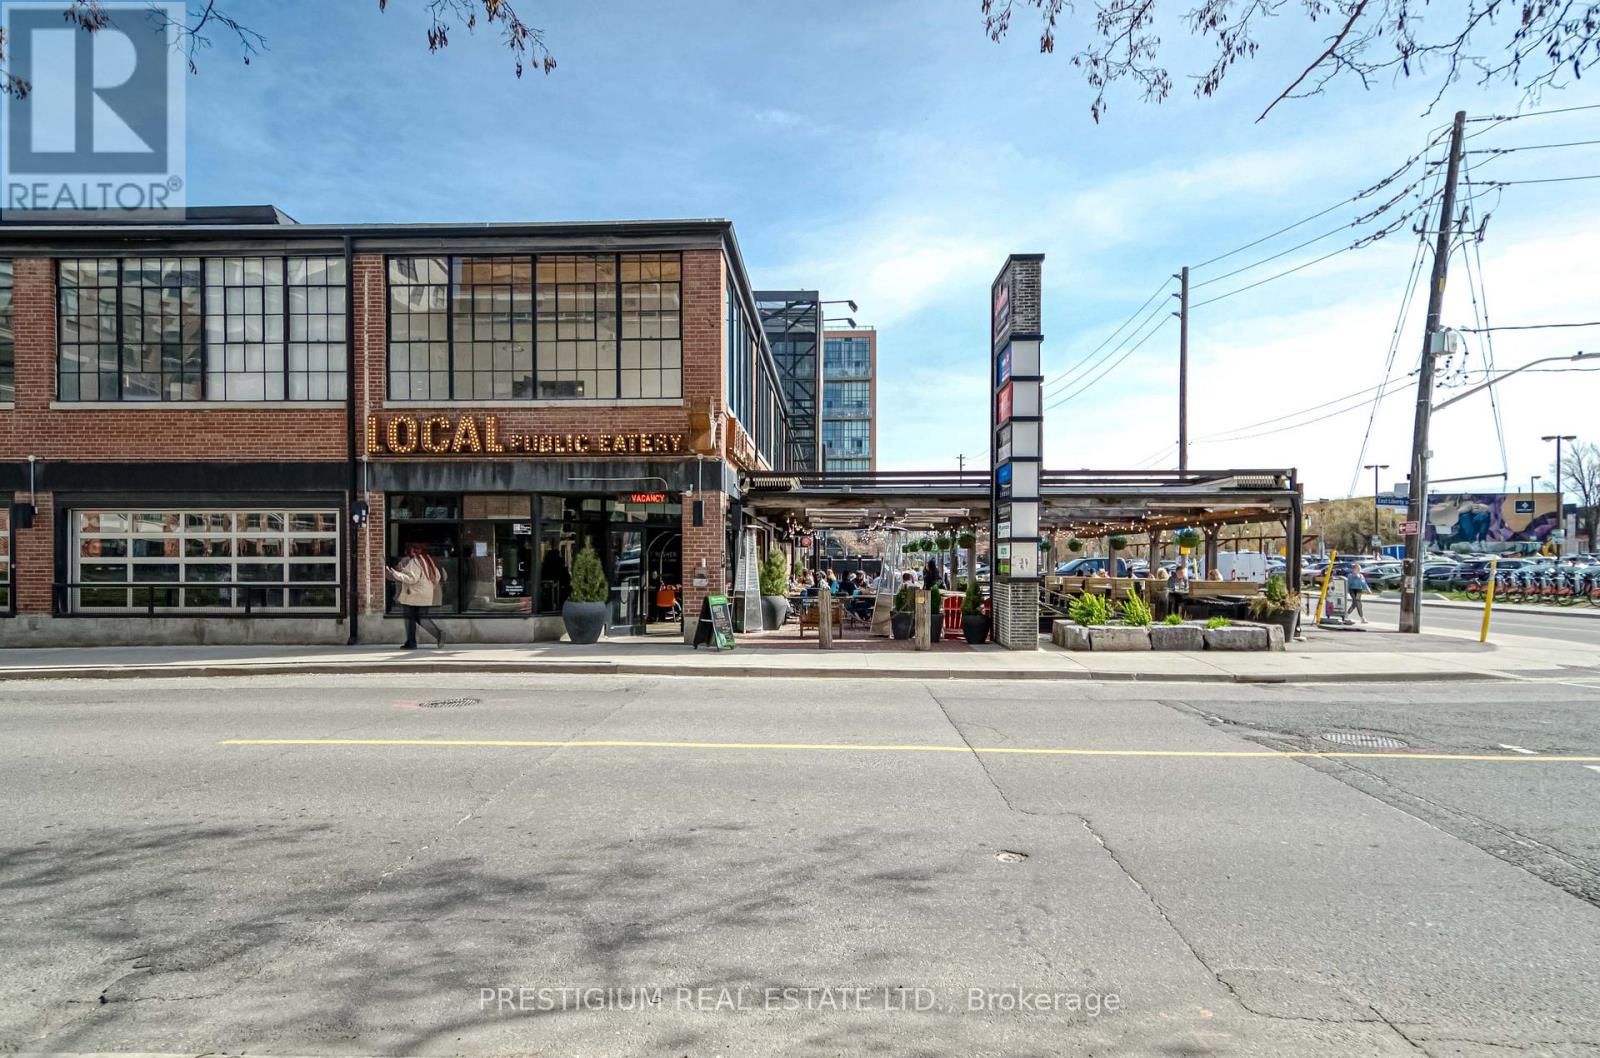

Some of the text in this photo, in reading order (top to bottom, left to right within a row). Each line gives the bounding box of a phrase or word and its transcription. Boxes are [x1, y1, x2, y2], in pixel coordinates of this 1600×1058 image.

[367, 415, 683, 453] LOCAL PUBLIC EATERY
[631, 493, 665, 503] VACANCY
